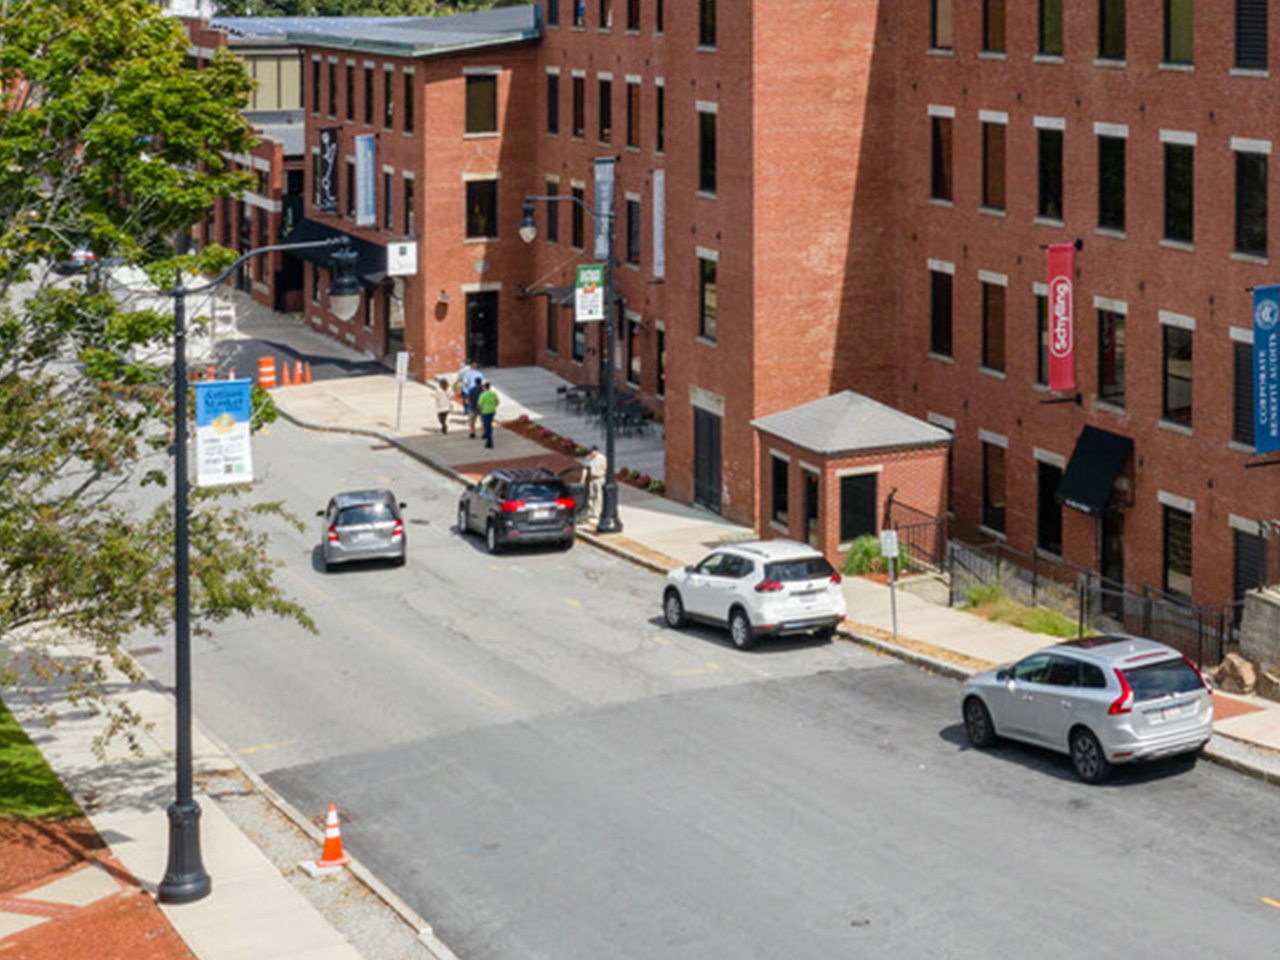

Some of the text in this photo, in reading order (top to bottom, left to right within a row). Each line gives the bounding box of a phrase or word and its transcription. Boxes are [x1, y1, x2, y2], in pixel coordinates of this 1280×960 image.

[1055, 283, 1069, 350] Schylling
[1259, 350, 1268, 425] CORPORATE
[1269, 333, 1278, 437] BENEFIT AUDITS
